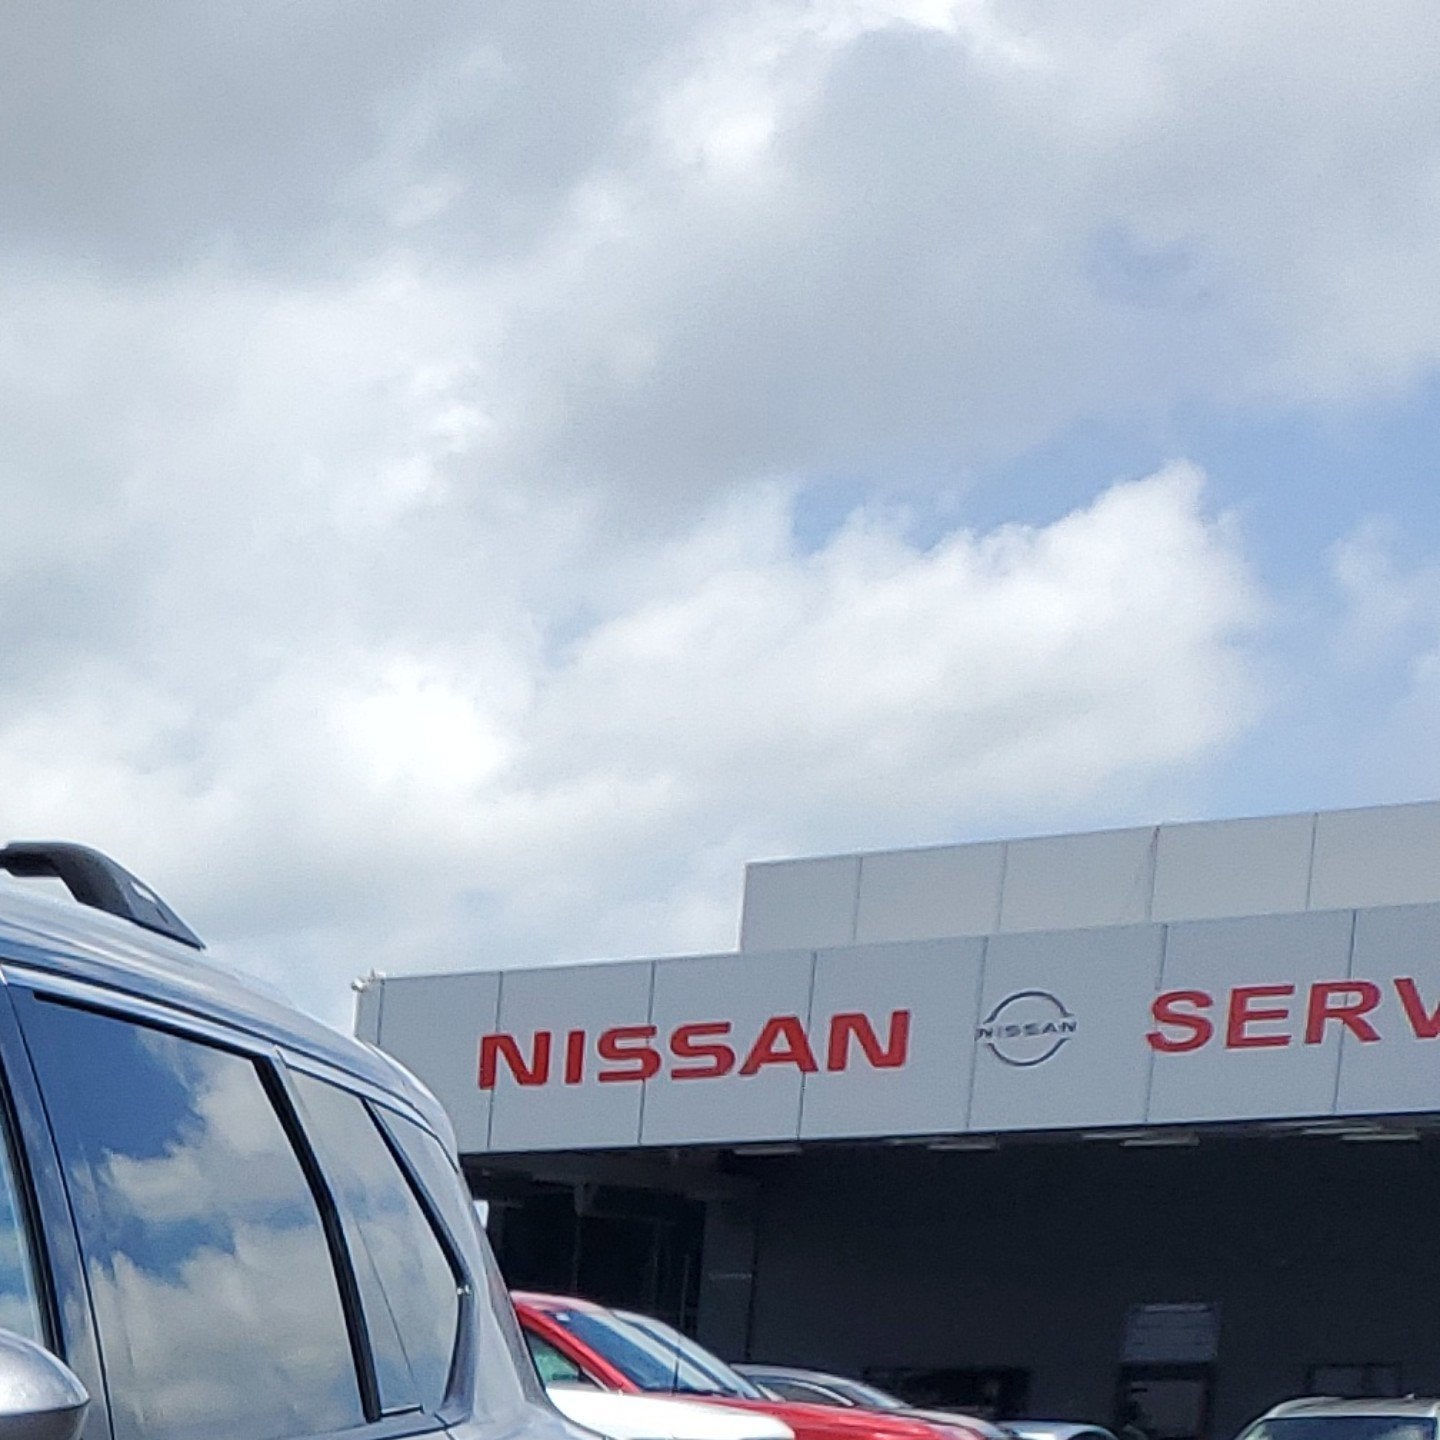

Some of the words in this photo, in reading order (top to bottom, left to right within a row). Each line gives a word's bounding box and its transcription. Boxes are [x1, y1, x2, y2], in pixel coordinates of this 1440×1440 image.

[479, 1011, 908, 1089] NISSAN
[1146, 977, 1440, 1053] SERV
[974, 1020, 1077, 1041] NISSAN
